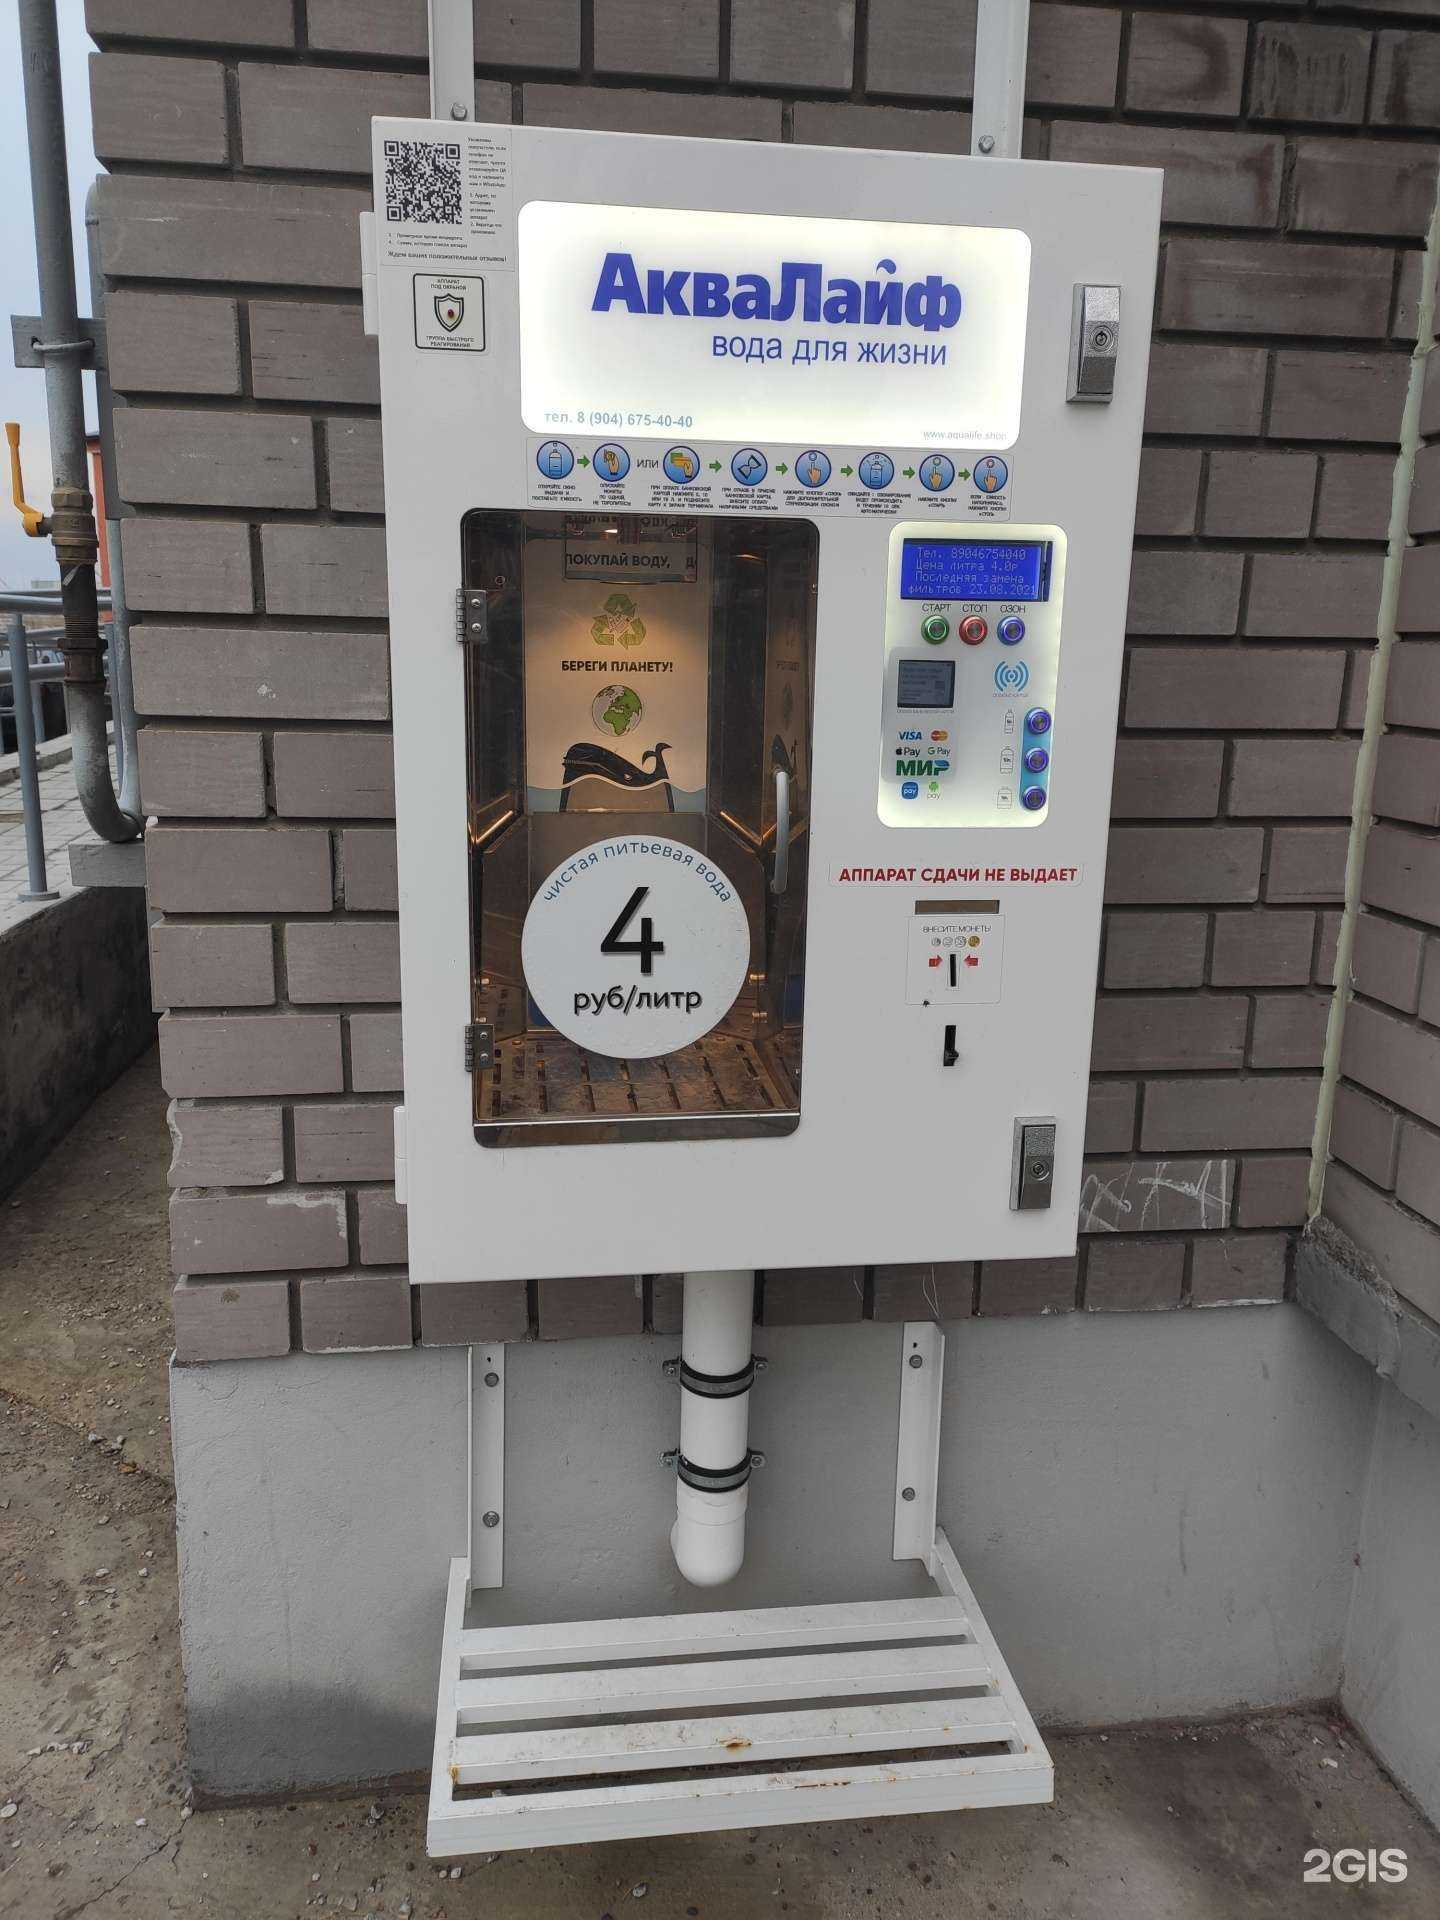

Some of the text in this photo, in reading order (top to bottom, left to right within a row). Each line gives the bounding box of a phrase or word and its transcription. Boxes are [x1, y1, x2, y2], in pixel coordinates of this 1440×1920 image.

[591, 252, 962, 332] АкваЛайф
[712, 335, 946, 365] вода для жизни
[544, 411, 693, 427] тел. 8 (904) 675-40-40
[636, 459, 659, 468] ИЛИ
[918, 547, 942, 559] Тел.
[566, 553, 628, 566] ПОКУПАЙ
[632, 555, 671, 568] ВОДУ,
[916, 559, 944, 571] Цена
[950, 561, 985, 571] литра
[915, 571, 1024, 584] Последняя замена
[908, 585, 962, 594] фильтров
[922, 603, 1026, 613] СТАРТ СТОП ОЗОН
[561, 660, 673, 672] БЕРЕГИ ПЛАНЕТУ!
[899, 732, 922, 740] VISA
[904, 747, 920, 757] Pay
[937, 747, 951, 756] Pay
[896, 760, 950, 776] МИР
[543, 842, 731, 902] чистая питьевая вода
[839, 868, 1077, 883] АППАРАТ СДАЧИ НЕ ВЫДАЕТ
[601, 887, 664, 974] 4
[574, 985, 702, 1016] руб/литр
